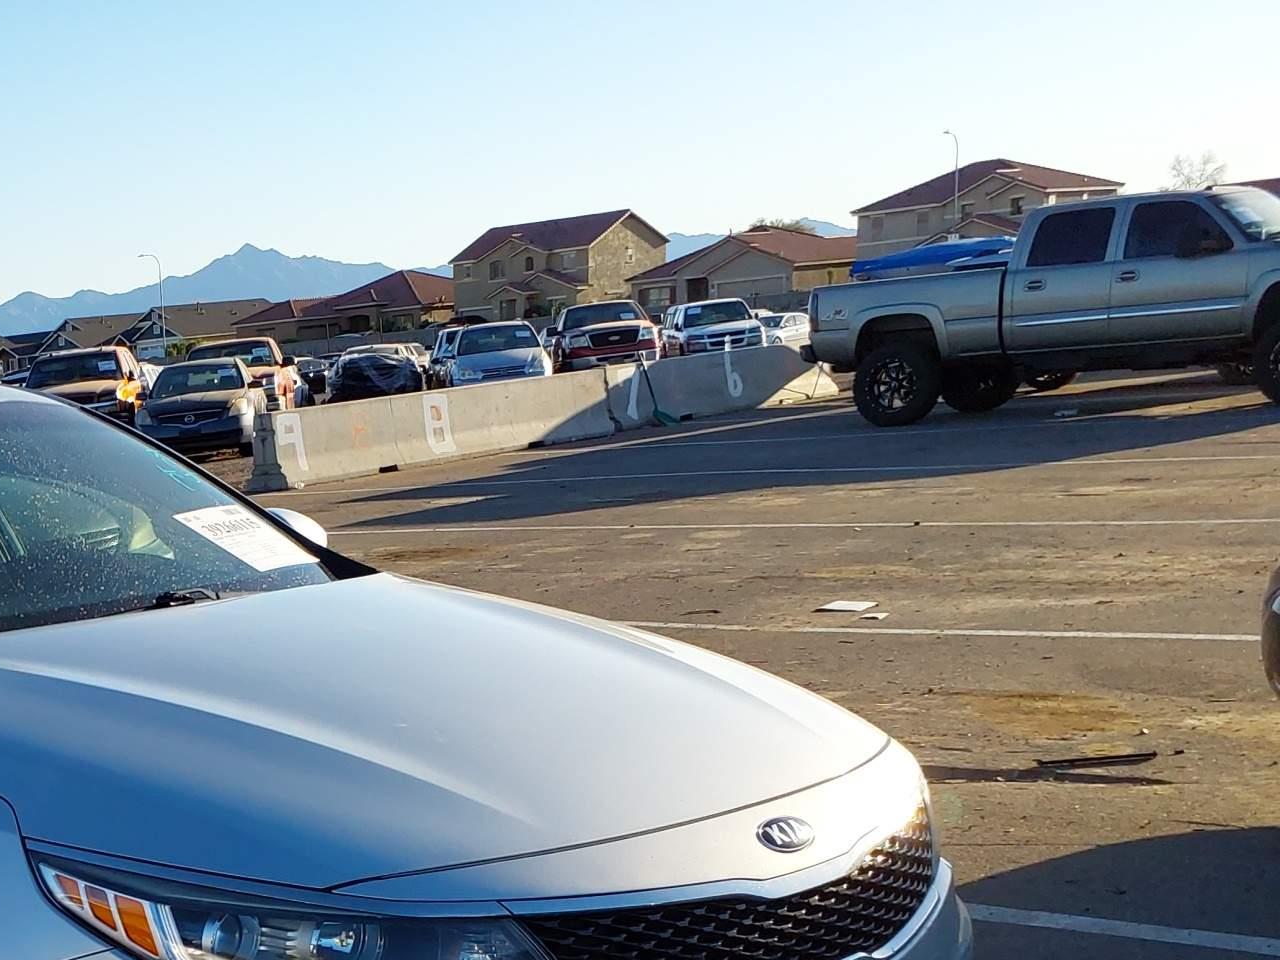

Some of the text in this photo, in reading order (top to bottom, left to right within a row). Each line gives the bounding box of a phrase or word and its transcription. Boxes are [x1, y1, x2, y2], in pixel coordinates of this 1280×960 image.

[724, 344, 743, 398] 6
[276, 413, 309, 472] 9
[422, 393, 457, 455] 8
